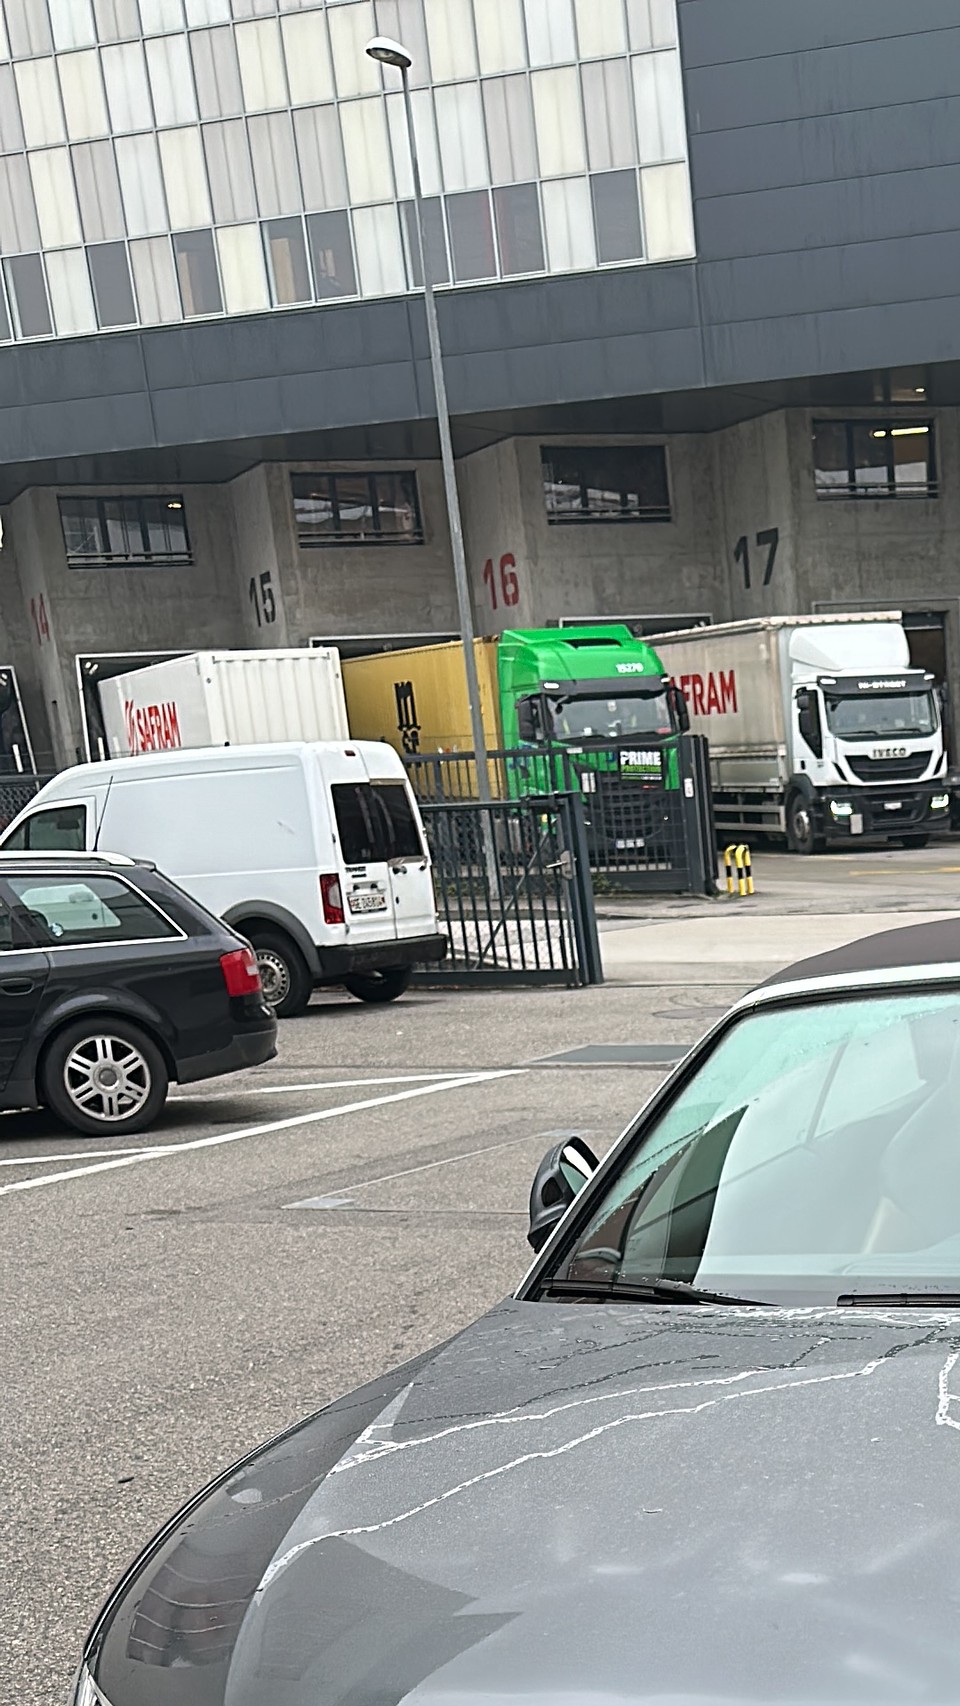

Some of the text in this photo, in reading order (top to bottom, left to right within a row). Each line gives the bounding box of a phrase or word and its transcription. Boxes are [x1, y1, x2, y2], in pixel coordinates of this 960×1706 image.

[483, 553, 519, 610] 16
[734, 527, 779, 589] 17
[31, 593, 51, 646] 14
[249, 571, 276, 627] 15
[136, 701, 182, 752] SAFRAM
[873, 747, 906, 758] IVECO
[620, 751, 662, 766] PRIME
